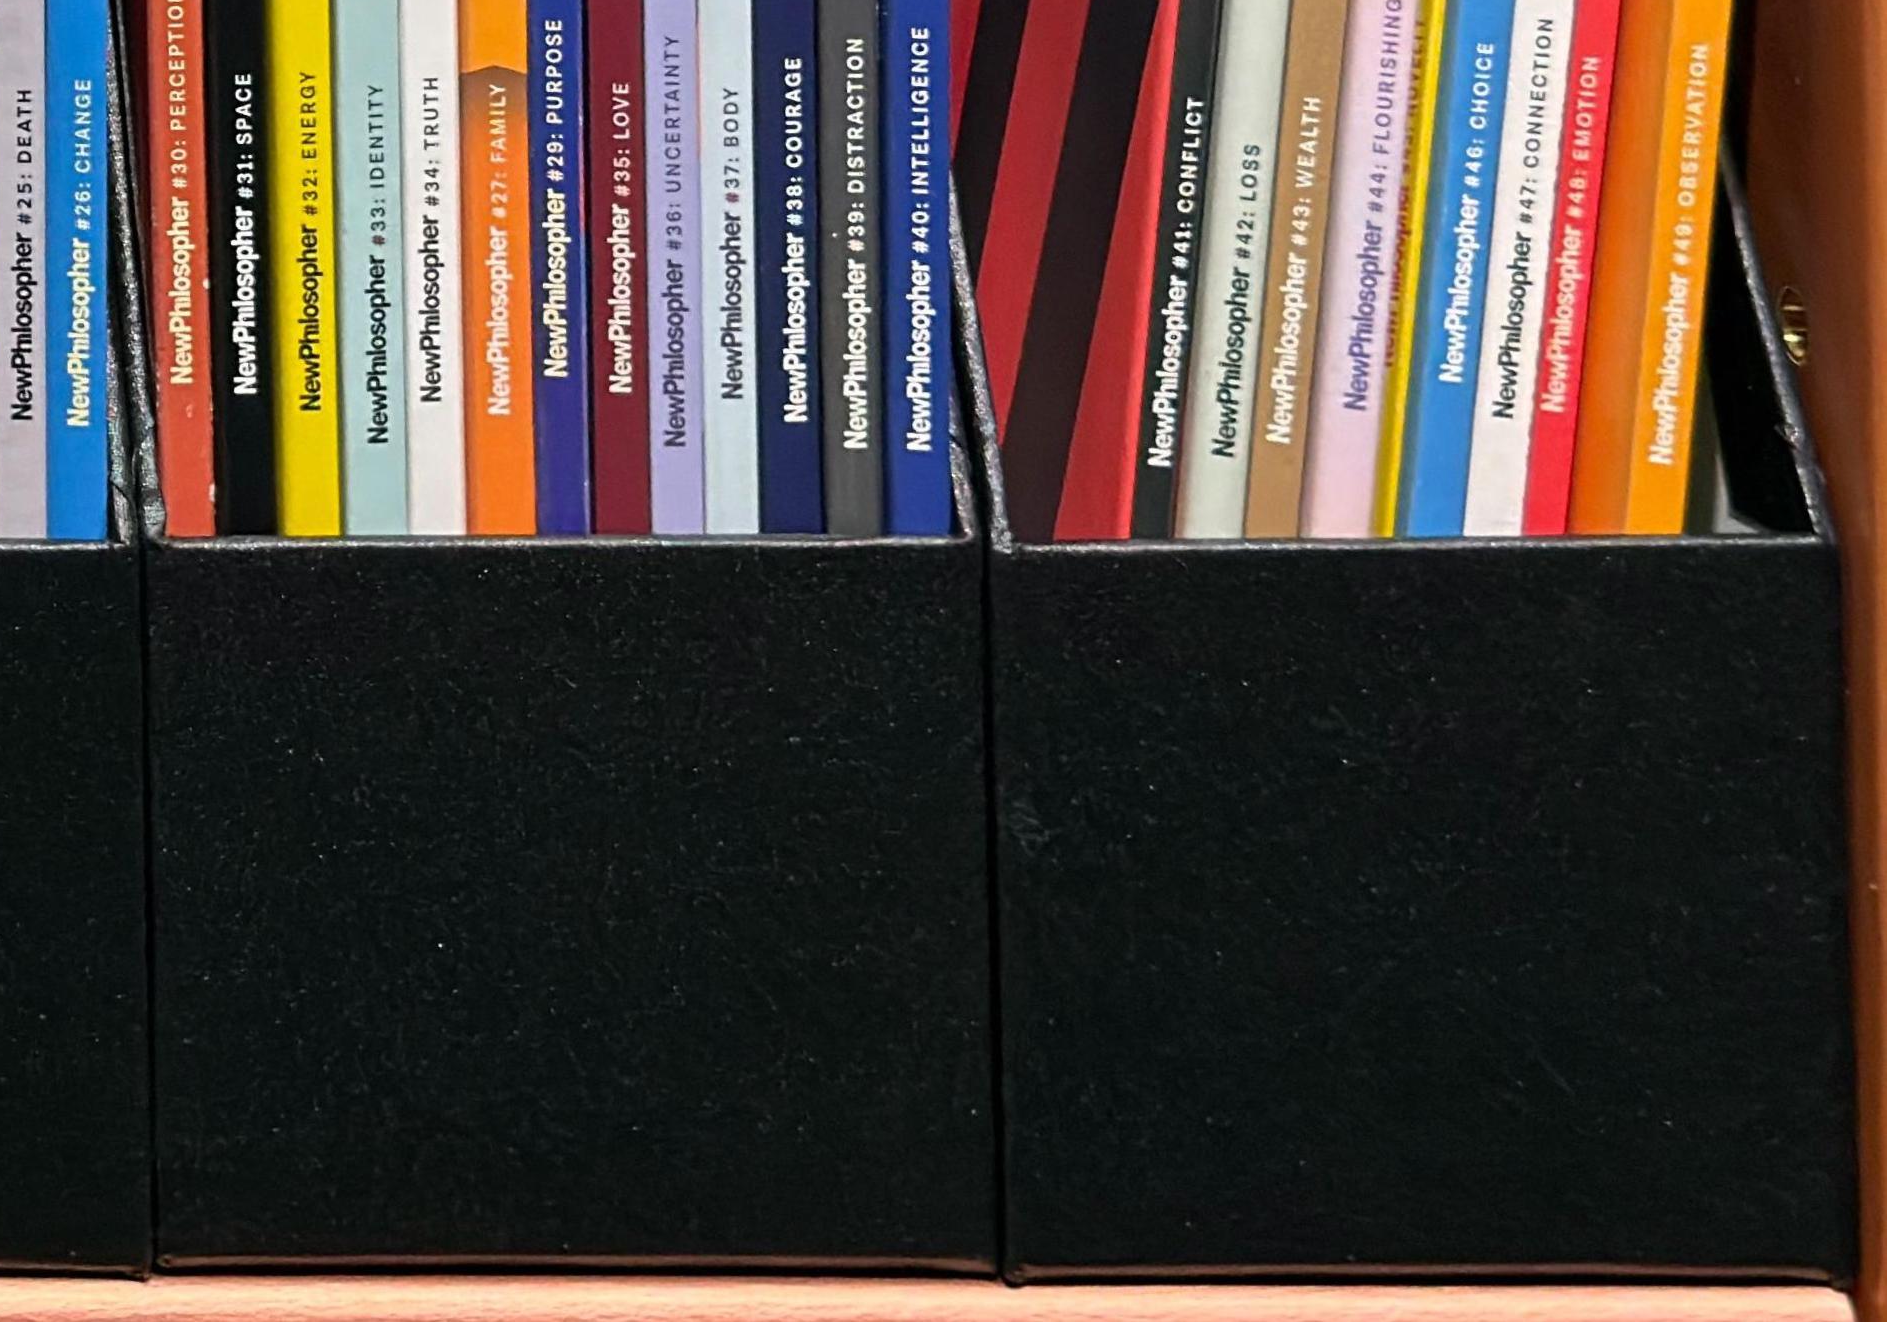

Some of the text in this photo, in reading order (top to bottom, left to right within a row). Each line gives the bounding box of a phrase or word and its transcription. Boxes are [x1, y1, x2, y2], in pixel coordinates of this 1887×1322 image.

[11, 91, 37, 420] NewPhilosopher #25: DEATH
[67, 81, 95, 426] NewPhilosopher #26: CHANGE
[167, 197, 195, 384] NewPhilosopher
[171, 141, 187, 188] #30:
[231, 74, 259, 394] NewPhilosopher #31: SPACE
[607, 84, 635, 393] NewPhilosopher #35: LOVE
[781, 58, 810, 422] NewPhilosopher #38: COURAGE
[842, 39, 872, 448] NewPhilosopher #39: DISTRACTION
[906, 28, 936, 451] NewPhilosopher #40: INTELLIGENCE
[1147, 98, 1203, 467] NewPhilosopher #41: CONFLICT
[1212, 145, 1260, 457] NewPhilosopher #42: LOSS
[1266, 98, 1320, 443] NewPhilosopher #43: WEALTH
[1439, 44, 1493, 382] NewPhilosopher #46: CHOICE
[1493, 19, 1553, 418] NewPhilosopher #47: CONNECTION
